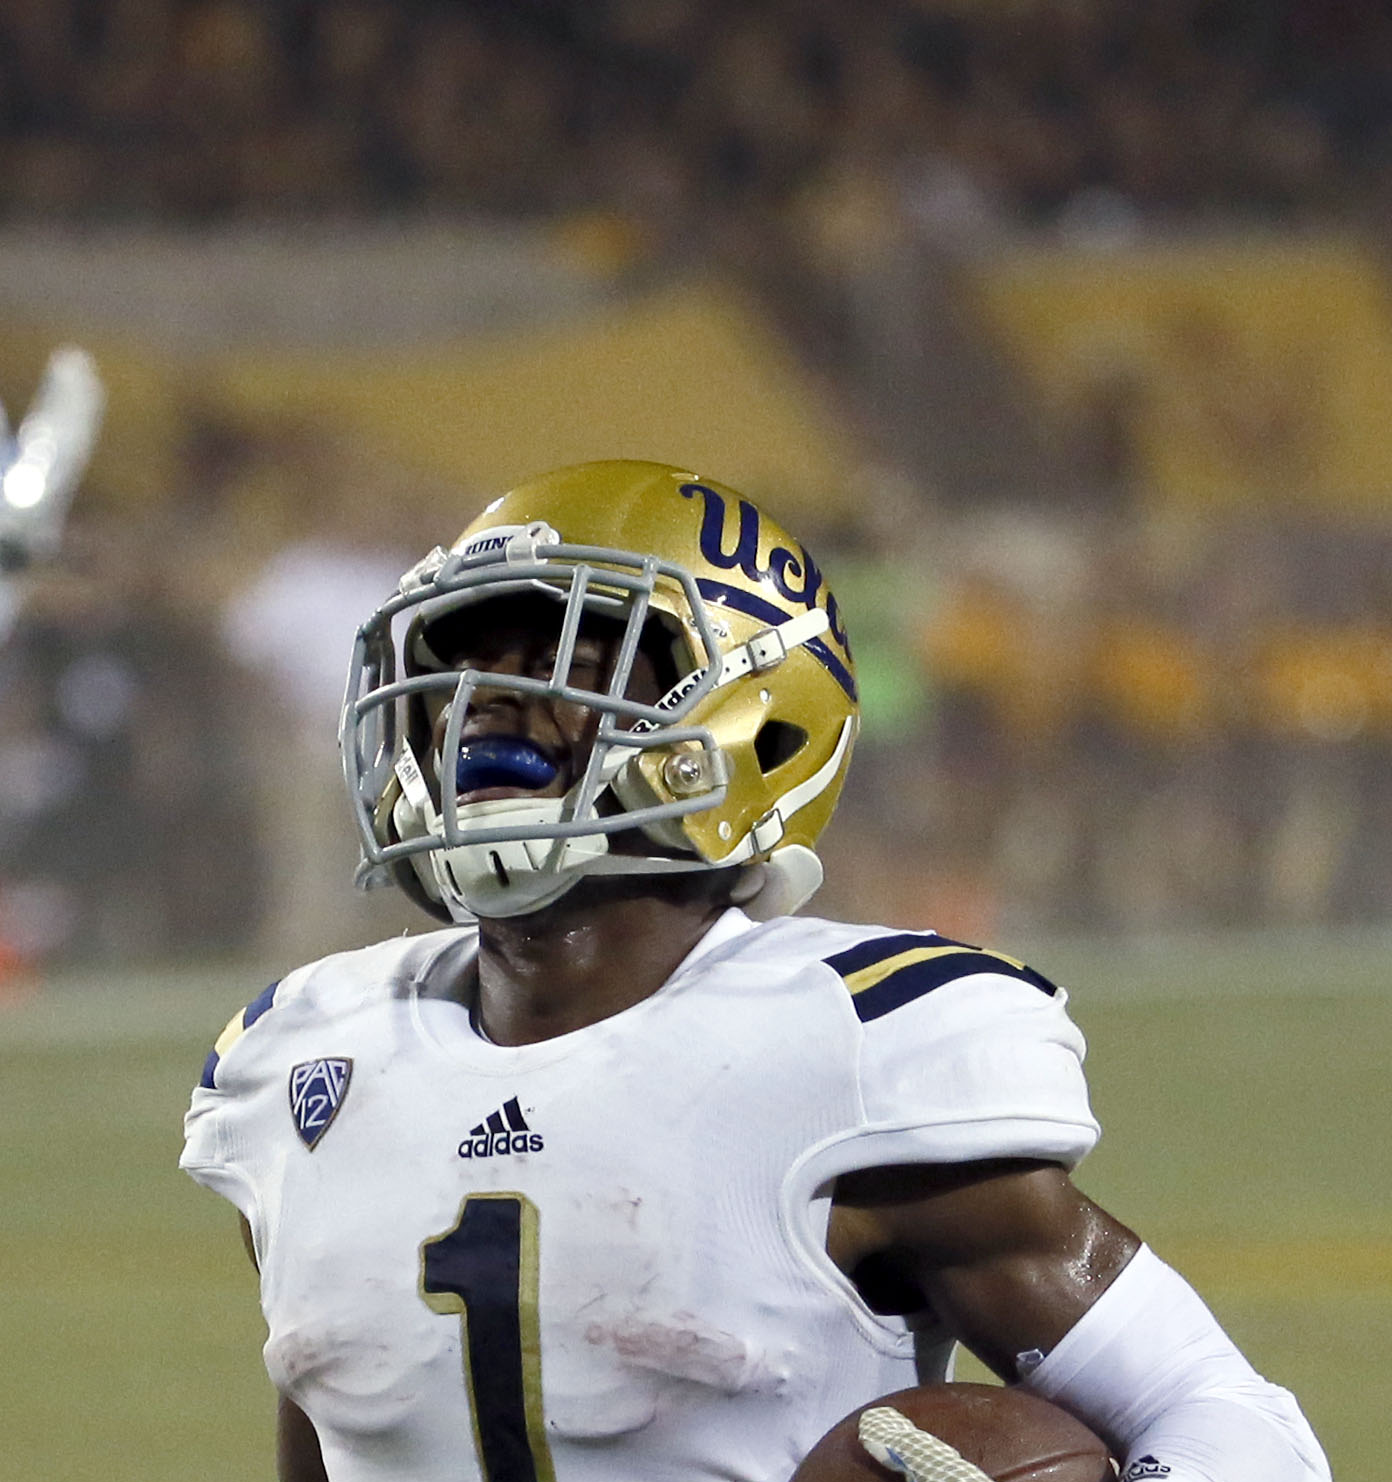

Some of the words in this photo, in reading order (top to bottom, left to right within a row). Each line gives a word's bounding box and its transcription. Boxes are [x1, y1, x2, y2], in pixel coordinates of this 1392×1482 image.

[292, 1060, 347, 1114] PAC
[300, 1094, 328, 1129] 12
[457, 1130, 544, 1158] adidas
